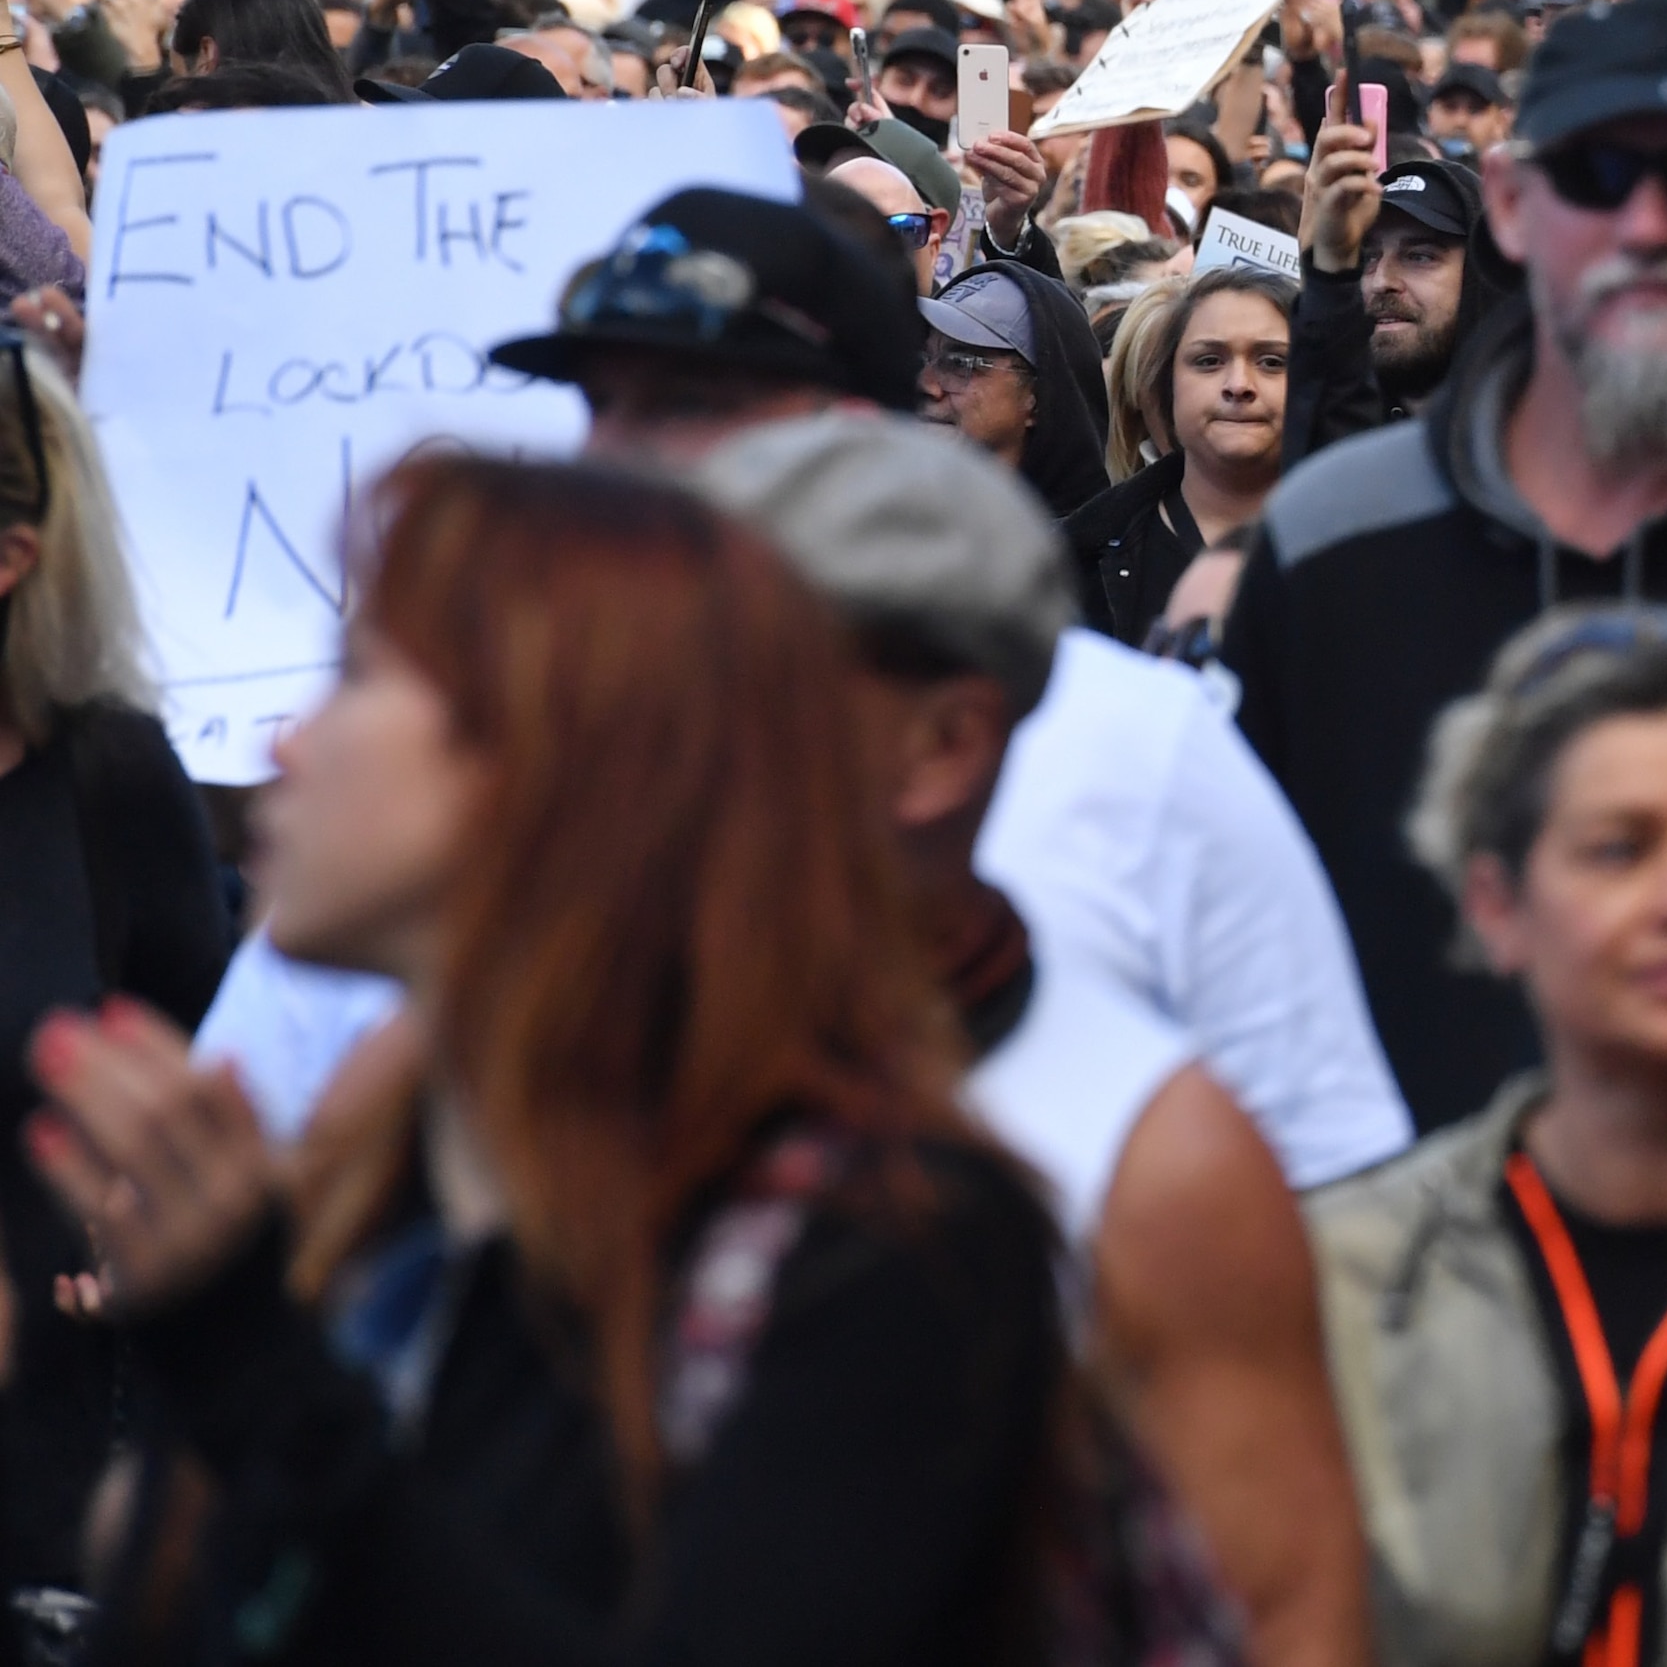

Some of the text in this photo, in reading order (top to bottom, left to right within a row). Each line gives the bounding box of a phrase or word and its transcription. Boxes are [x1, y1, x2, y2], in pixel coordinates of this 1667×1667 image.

[107, 151, 532, 299] END THE
[1217, 224, 1300, 273] TRUE LIFE
